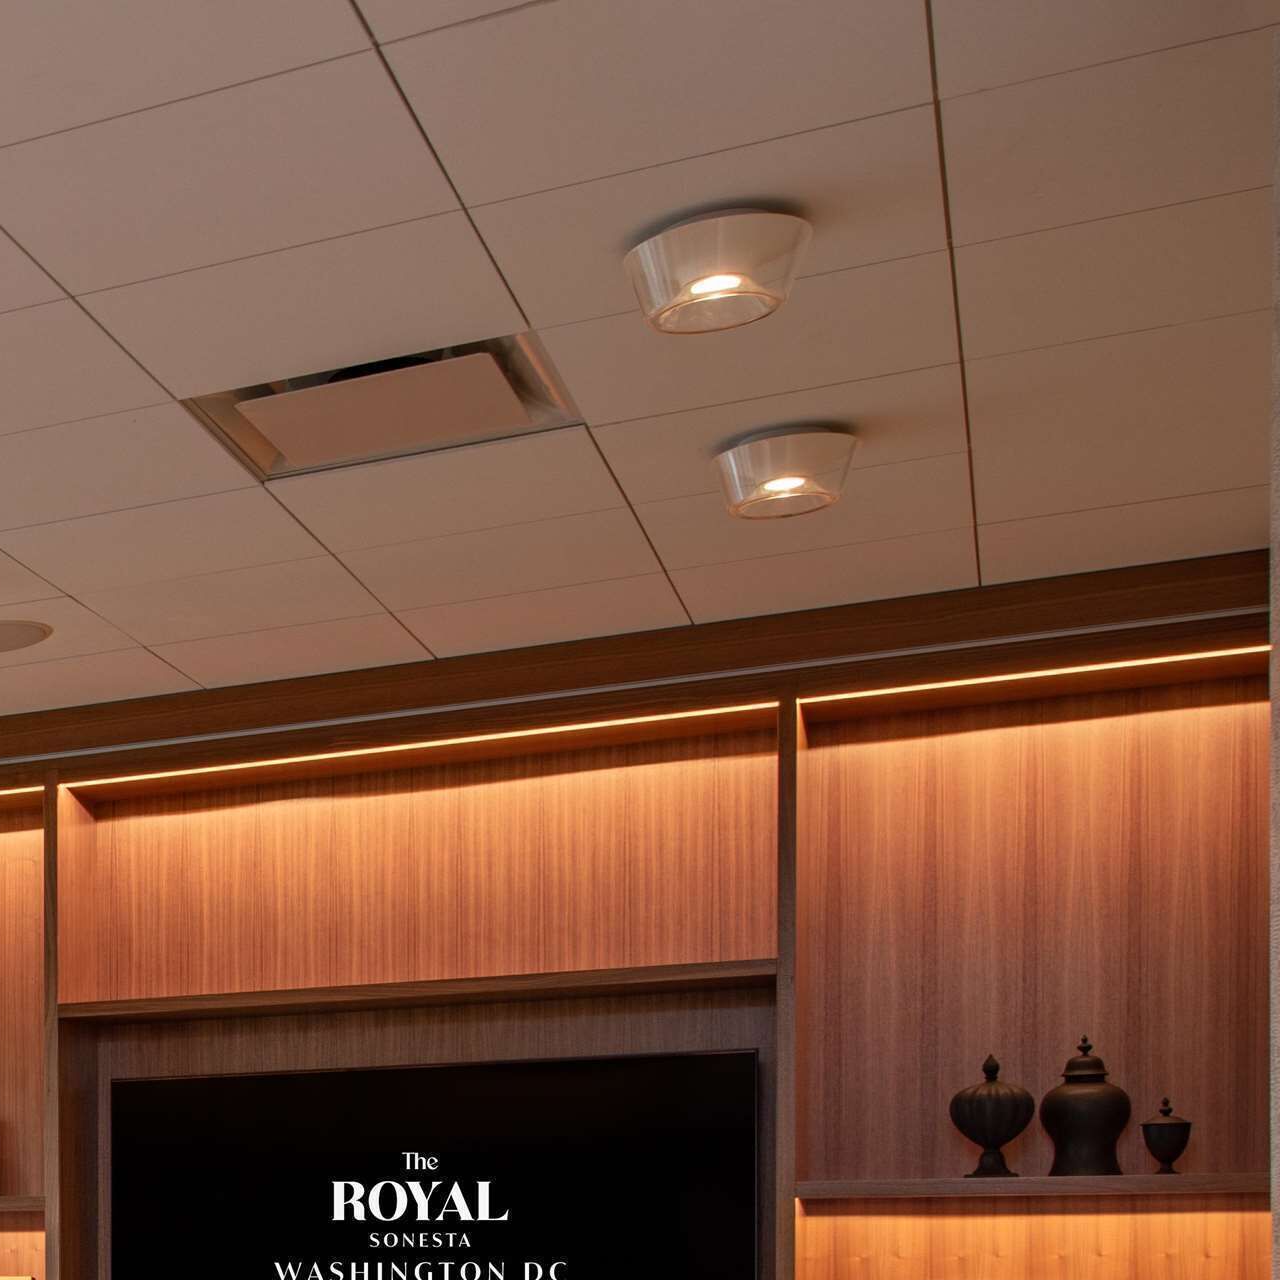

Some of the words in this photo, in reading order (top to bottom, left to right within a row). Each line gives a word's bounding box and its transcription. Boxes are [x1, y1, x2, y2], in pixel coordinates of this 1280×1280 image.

[401, 1151, 439, 1170] The
[330, 1180, 510, 1222] ROYAL
[369, 1232, 472, 1248] SONESTA
